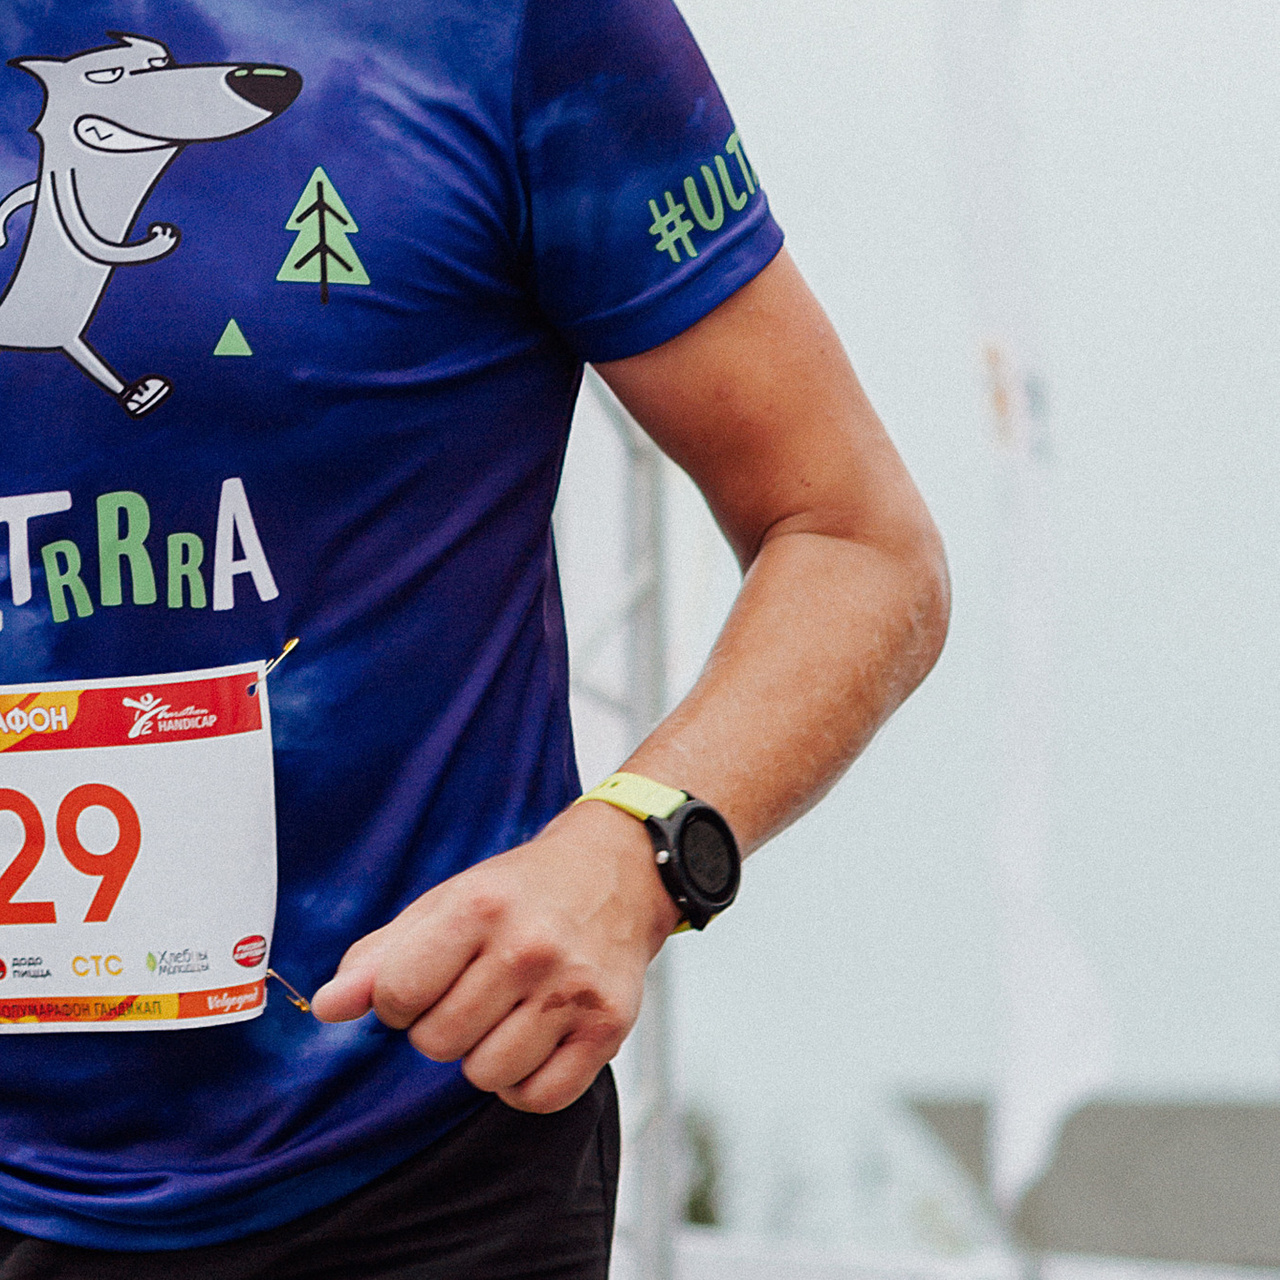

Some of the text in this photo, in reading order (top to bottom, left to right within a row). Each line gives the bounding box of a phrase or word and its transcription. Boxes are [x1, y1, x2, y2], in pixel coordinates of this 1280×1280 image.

[648, 128, 760, 263] #ULT
[157, 714, 217, 733] HANDICAP
[72, 955, 123, 977] СТС
[94, 1001, 162, 1017] ГАНДИКАП
[207, 987, 258, 1012] Volgograd
